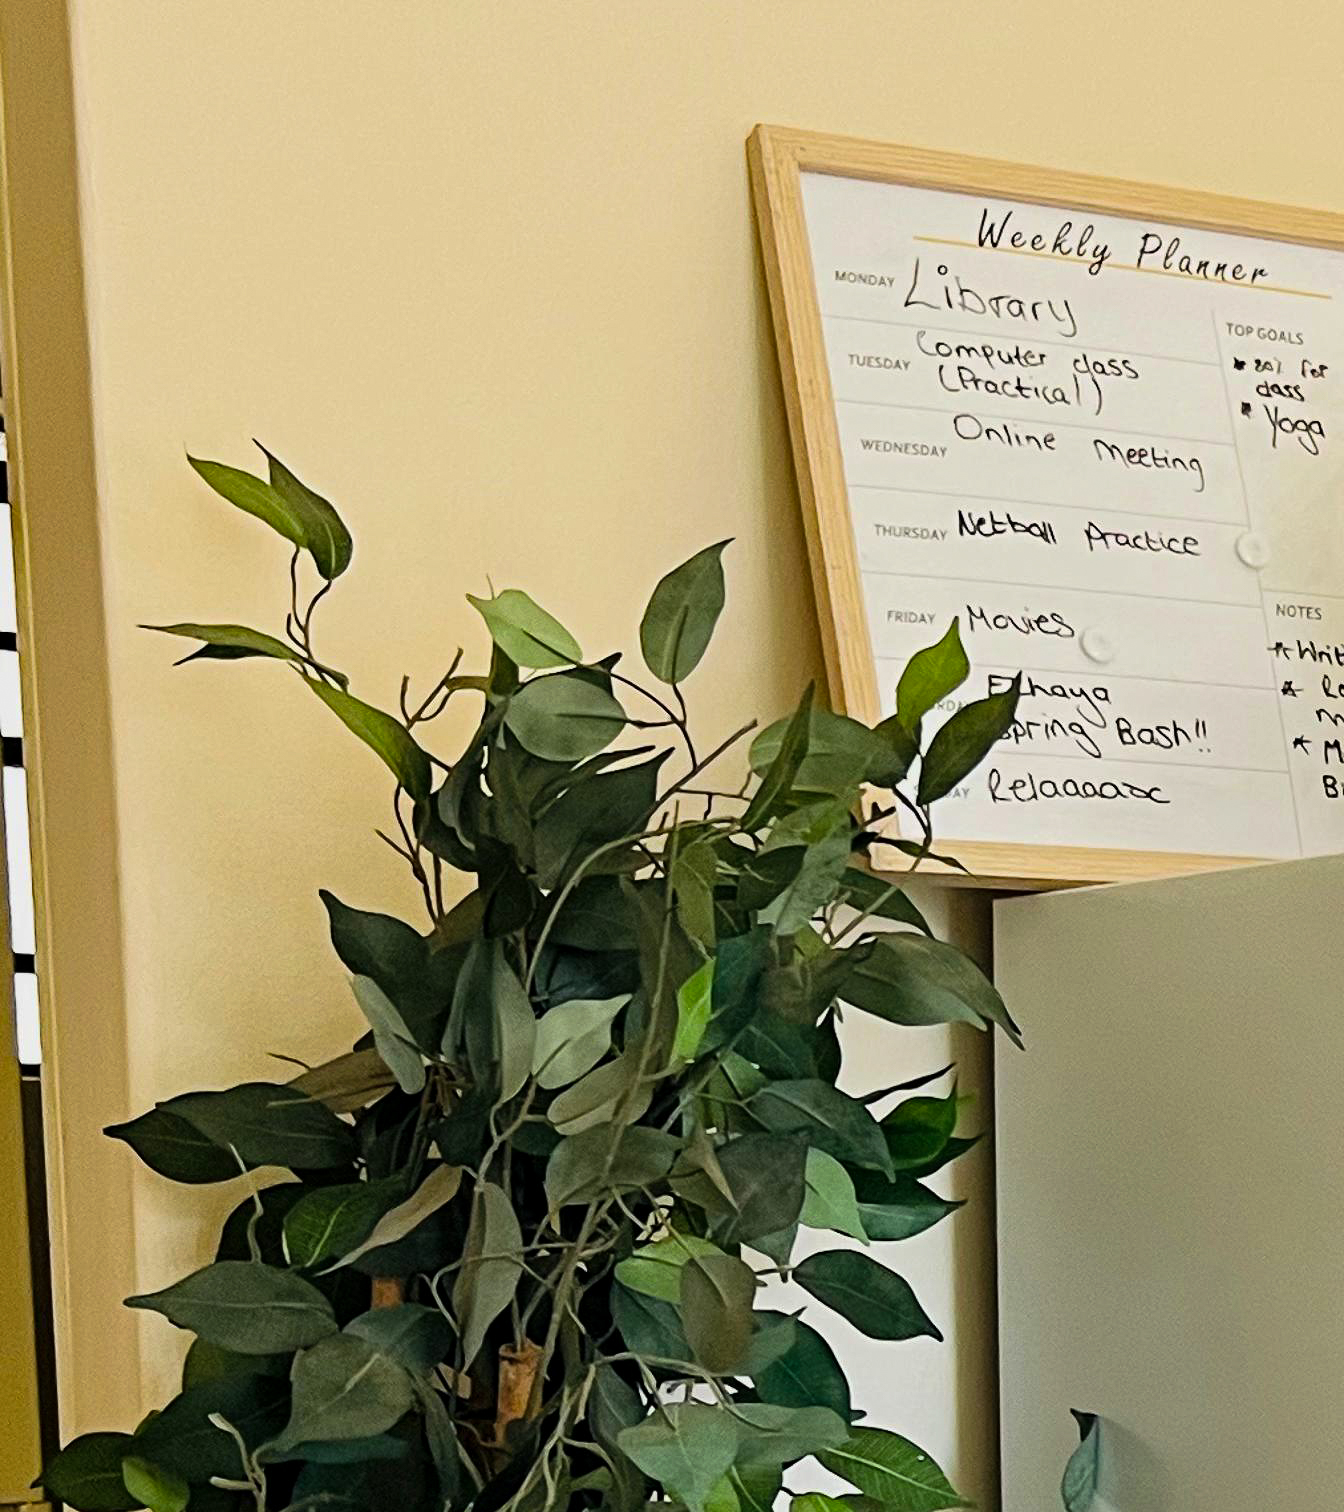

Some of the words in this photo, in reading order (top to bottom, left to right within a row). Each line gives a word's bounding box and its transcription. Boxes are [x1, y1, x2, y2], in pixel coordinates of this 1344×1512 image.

[978, 208, 1112, 275] Weekly
[1137, 233, 1274, 284] Planner
[835, 270, 895, 288] MONDAY
[904, 257, 1079, 337] Library
[1226, 322, 1253, 337] TOP
[1257, 327, 1304, 346] GOALS
[848, 354, 910, 371] TUESDAY
[916, 330, 1047, 369] Computer
[1073, 354, 1139, 379] class
[939, 365, 1102, 416] (Practical)
[953, 414, 1056, 451] Online
[1263, 403, 1325, 455] Yoga
[861, 439, 948, 458] WEDNESDAY
[875, 524, 948, 541] THURSDAY
[958, 509, 1057, 544] Netball
[887, 610, 936, 626] FRIDAY
[966, 605, 1075, 638] Movies
[1276, 604, 1322, 620] NOTES
[989, 674, 1112, 728] Ehaya
